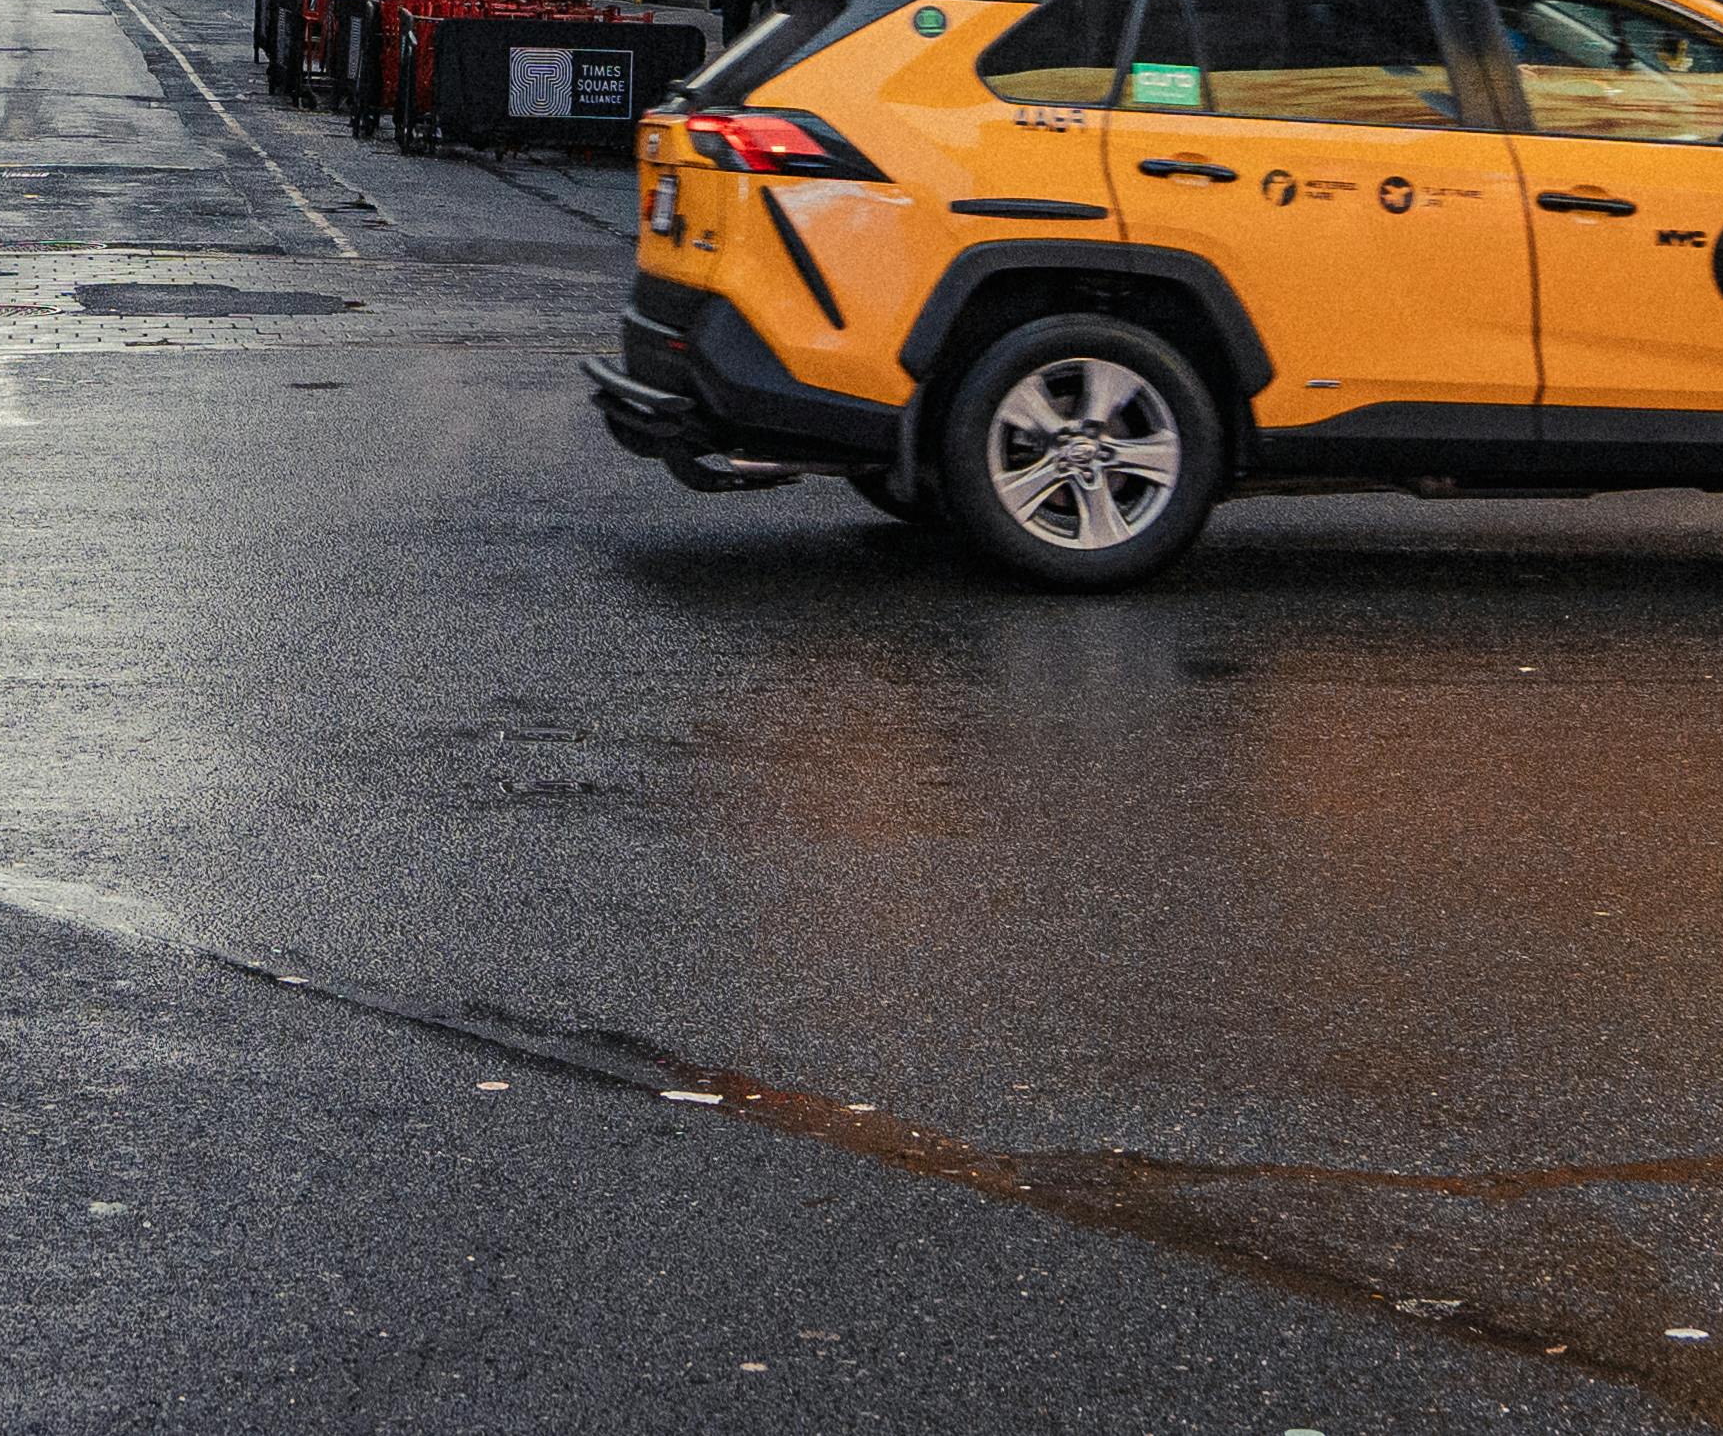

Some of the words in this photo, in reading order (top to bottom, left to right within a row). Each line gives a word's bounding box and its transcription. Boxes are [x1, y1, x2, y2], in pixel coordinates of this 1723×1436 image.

[581, 64, 622, 78] TIMES
[577, 79, 625, 93] SQUARE
[578, 94, 623, 104] ALLIANCE
[1655, 229, 1708, 249] NYC
